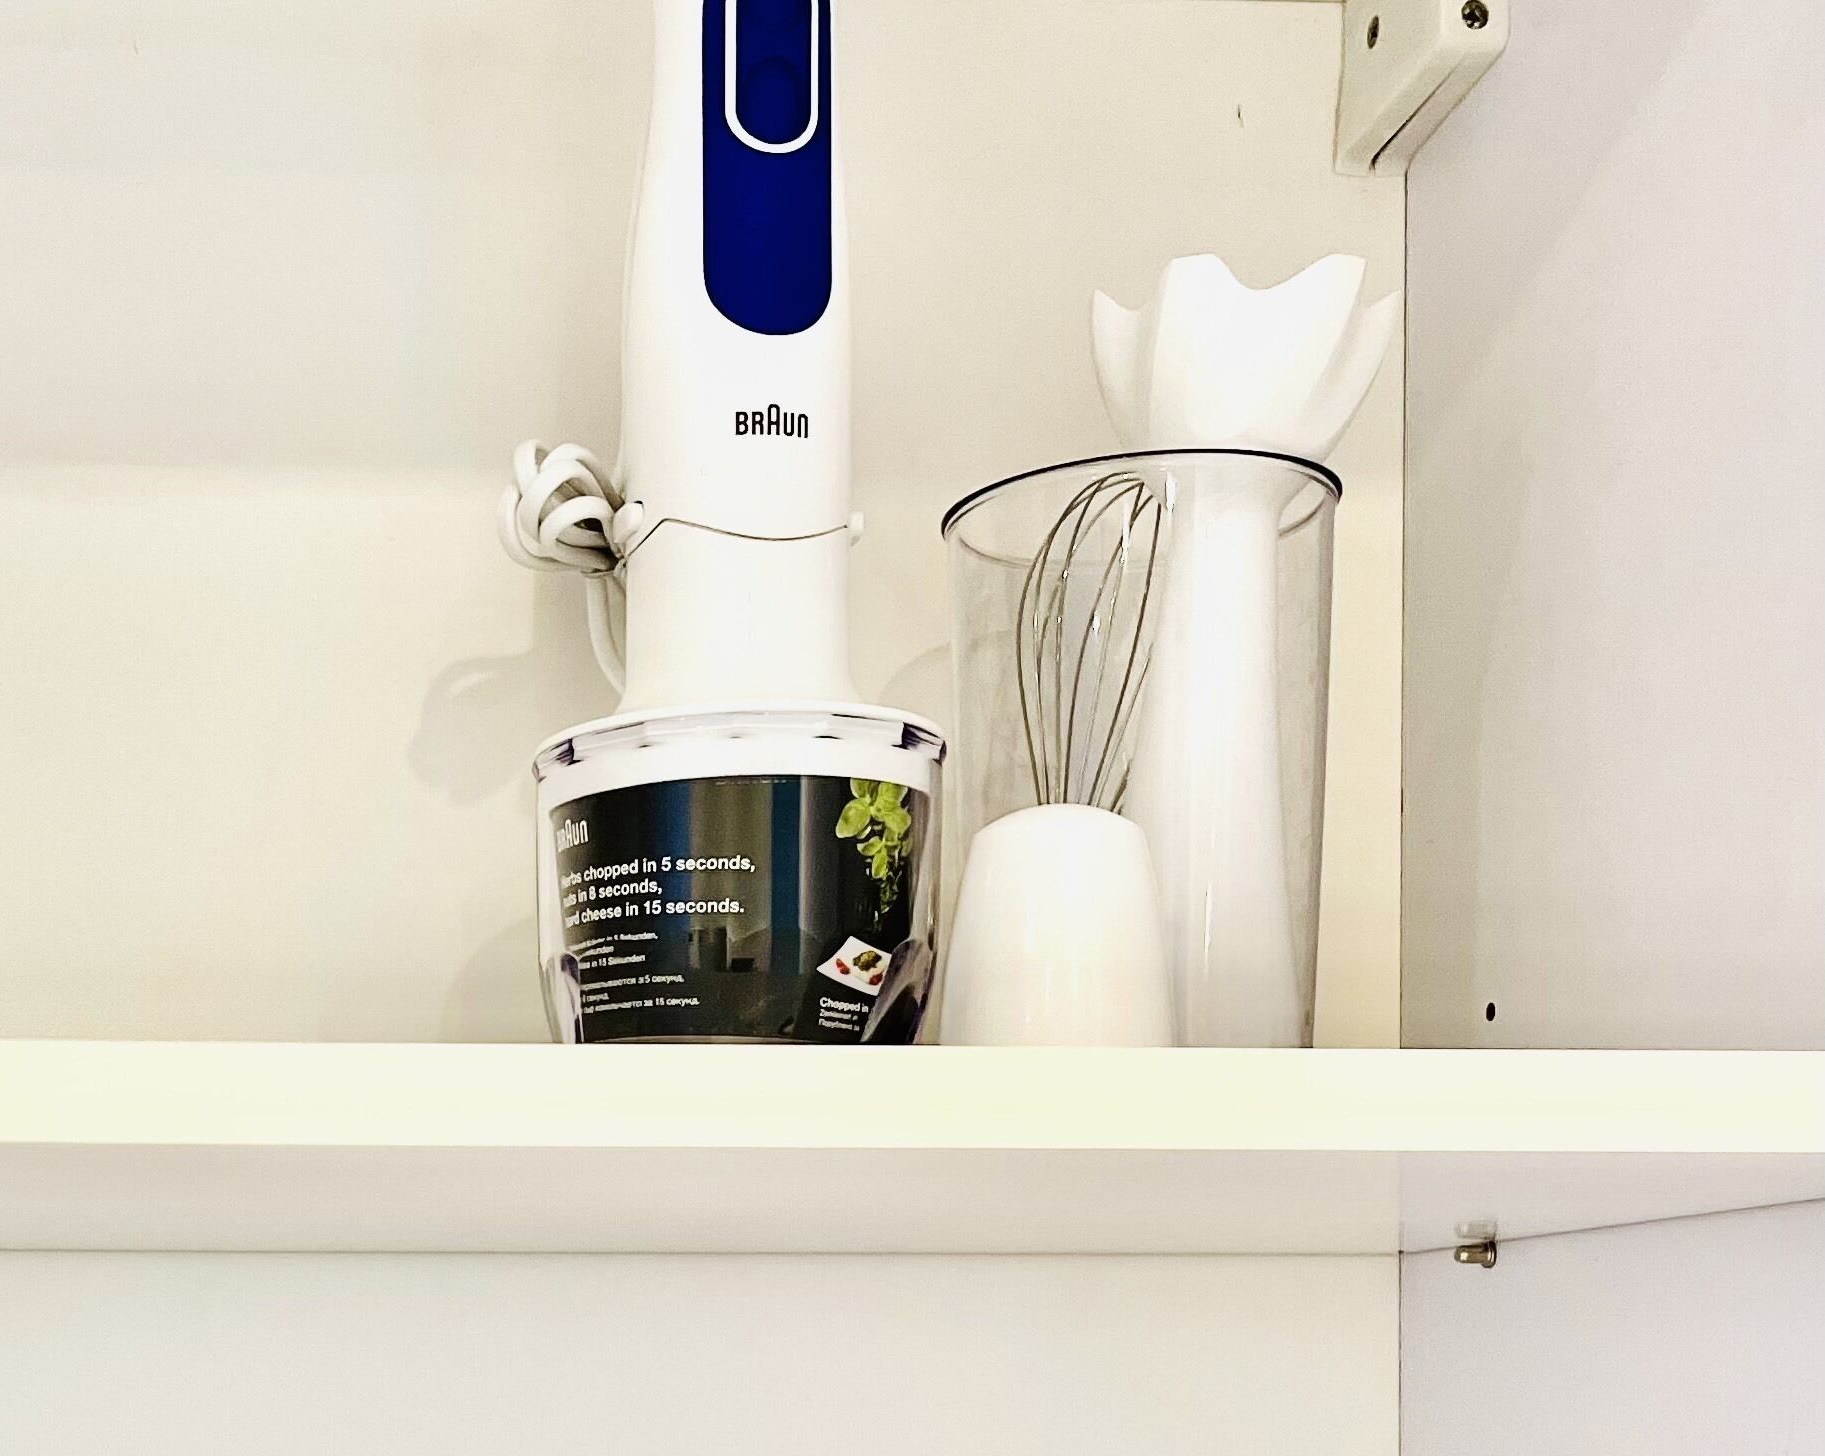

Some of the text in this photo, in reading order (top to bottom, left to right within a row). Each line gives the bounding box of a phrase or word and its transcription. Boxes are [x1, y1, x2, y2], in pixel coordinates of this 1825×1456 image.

[735, 403, 809, 439] BRAUN
[583, 858, 639, 882] chopped
[642, 857, 657, 873] in
[660, 856, 672, 872] 5
[675, 854, 756, 873] seconds,
[577, 888, 588, 903] in
[588, 885, 597, 901] 8
[598, 878, 663, 899] seconds,
[581, 907, 623, 924] cheese
[625, 901, 639, 917] in
[643, 899, 662, 915] 15
[665, 897, 745, 914] seconds.
